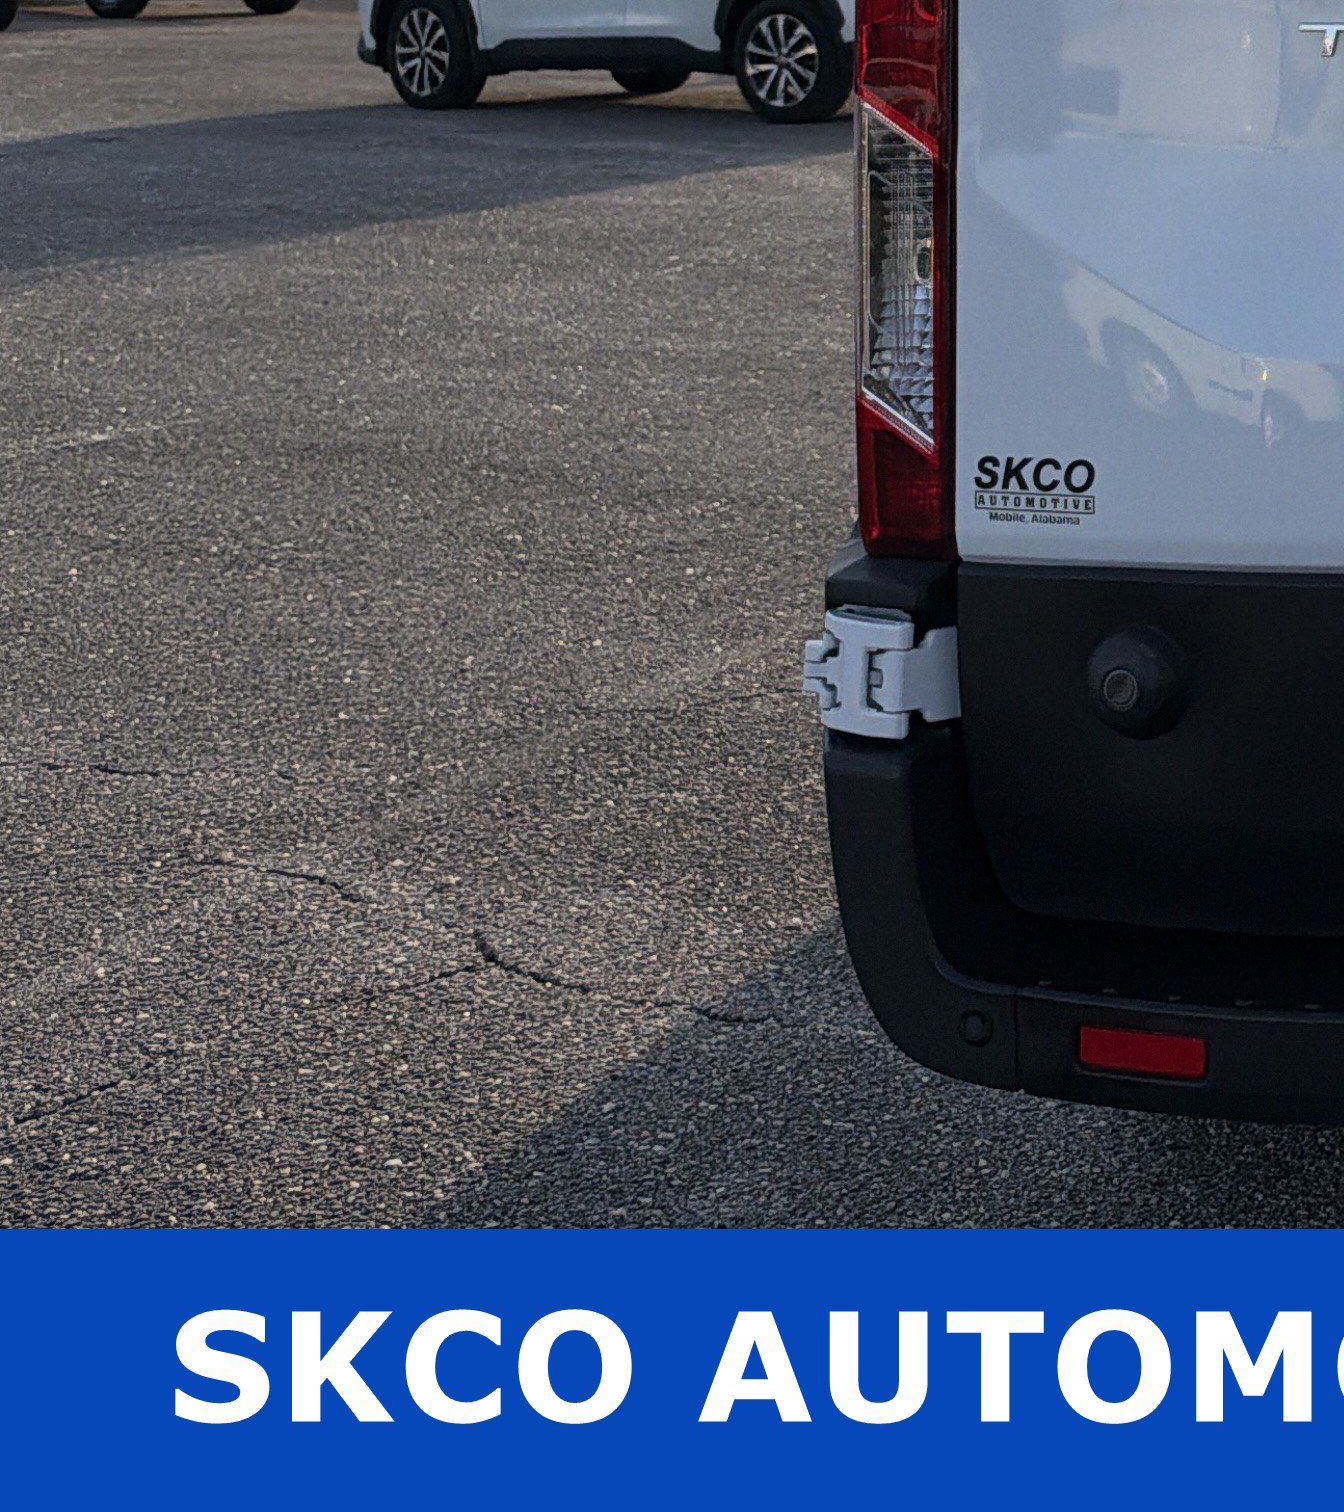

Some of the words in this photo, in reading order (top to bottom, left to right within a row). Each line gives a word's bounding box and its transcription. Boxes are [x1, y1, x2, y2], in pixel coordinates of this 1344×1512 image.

[974, 455, 1095, 494] SKCO
[977, 494, 1092, 511] AUTOMOTIVE
[1031, 514, 1081, 525] Alabama
